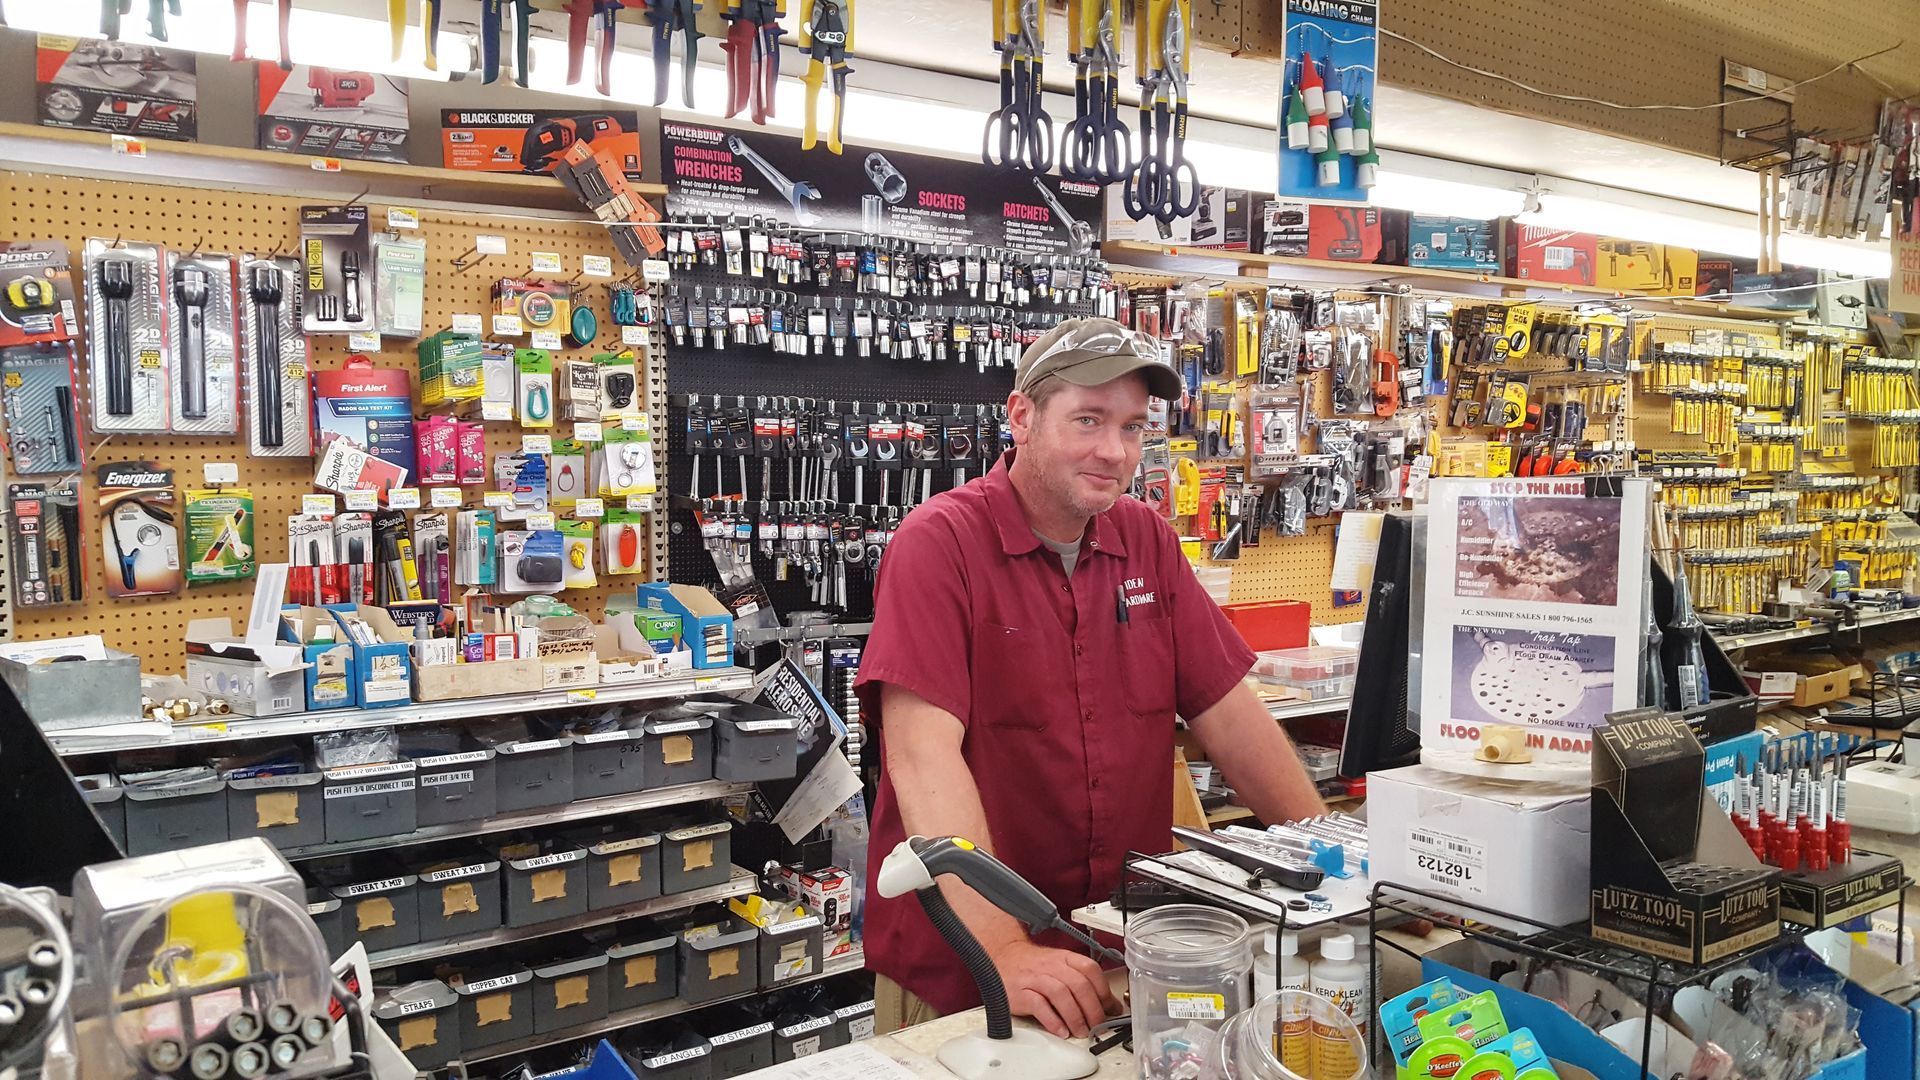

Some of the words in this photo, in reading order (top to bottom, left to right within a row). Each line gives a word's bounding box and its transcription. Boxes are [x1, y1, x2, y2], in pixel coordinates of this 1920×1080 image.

[1288, 0, 1348, 20] FLOATING
[1351, 6, 1362, 14] KEY
[340, 80, 356, 88] SKIL
[461, 113, 535, 124] BLACK&DECKER
[664, 125, 724, 141] POWERBUILT
[674, 146, 732, 162] COMBINATION
[674, 160, 742, 182] WRENCHES
[681, 180, 712, 190] Heat-treated
[718, 184, 746, 194] drop-forged
[1060, 182, 1100, 194] POWERBUILT
[690, 189, 710, 198] strength
[722, 192, 745, 200] durability
[918, 190, 966, 210] SOCKETS
[901, 214, 922, 222] durability
[1004, 202, 1049, 222] RATCHETS
[503, 278, 526, 288] Daisy
[1745, 283, 1772, 293] Makita
[149, 260, 160, 320] MAGLITE
[142, 357, 158, 365] 412
[289, 368, 303, 376] 412
[341, 384, 362, 392] First
[364, 384, 387, 392] Alert
[326, 451, 344, 492] Sharpie
[105, 472, 166, 486] Energizer
[1490, 482, 1523, 495] STOP
[1526, 482, 1550, 494] THE
[301, 523, 330, 535] Sharpie
[342, 522, 370, 533] Sharpie
[415, 519, 446, 532] Sharpie
[1461, 536, 1494, 544] Humidifier
[1459, 580, 1490, 588] Efficiency
[1459, 588, 1484, 596] Furnace
[1126, 592, 1155, 607] ARDWARE
[392, 610, 434, 620] WEBSTER'S
[1476, 610, 1514, 619] SUNSHINE
[1562, 616, 1593, 624] 796-1565
[654, 622, 676, 630] CURAD
[1514, 651, 1536, 660] FLOOR
[1542, 718, 1564, 727] MORE
[1566, 721, 1584, 729] WET
[1440, 724, 1480, 740] FLOO
[1611, 722, 1646, 750] LUTZ
[1644, 717, 1684, 738] TOOL
[1640, 738, 1673, 750] COMPANY
[423, 757, 436, 765] PUSH
[437, 756, 447, 764] FIT
[459, 752, 486, 761] COUPLING
[364, 764, 399, 774] DISCONNECT
[424, 776, 437, 784] PUSH
[438, 774, 448, 783] FIT
[462, 772, 471, 780] TEE
[326, 787, 342, 796] PUSH
[344, 786, 352, 794] FIT
[366, 782, 399, 792] DISCONNECT
[402, 780, 414, 788] TOOL
[528, 856, 554, 867] SWEAT
[556, 854, 562, 862] X
[564, 852, 574, 860] FIP
[434, 868, 459, 880] SWEAT
[462, 867, 468, 875] X
[470, 864, 483, 874] MIP
[1418, 854, 1472, 880] 162123
[351, 882, 378, 893] SWEAT
[381, 880, 388, 889] X
[390, 878, 402, 888] MIP
[1865, 872, 1884, 892] TOOL
[1602, 888, 1638, 911] LUTZ
[1643, 898, 1685, 927] TOOL
[1721, 898, 1744, 924] LUTZ
[1747, 886, 1768, 910] TOOL
[1620, 910, 1666, 926] COMPANY
[1732, 910, 1758, 924] COMPANY
[471, 978, 498, 990] COPPER
[500, 976, 514, 986] CAP
[1316, 986, 1362, 999] KERO-KLEAN
[404, 1000, 433, 1012] STRAPS
[837, 1007, 850, 1017] 5/8
[786, 1024, 798, 1035] 5/8
[800, 1018, 828, 1032] ANGLE
[714, 1034, 726, 1044] 1/2
[728, 1024, 772, 1041] STRAIGHT
[1404, 1033, 1422, 1045] Heal
[1474, 1032, 1500, 1048] Hands
[654, 1054, 668, 1066] 1/2
[670, 1048, 702, 1062] ANGLE
